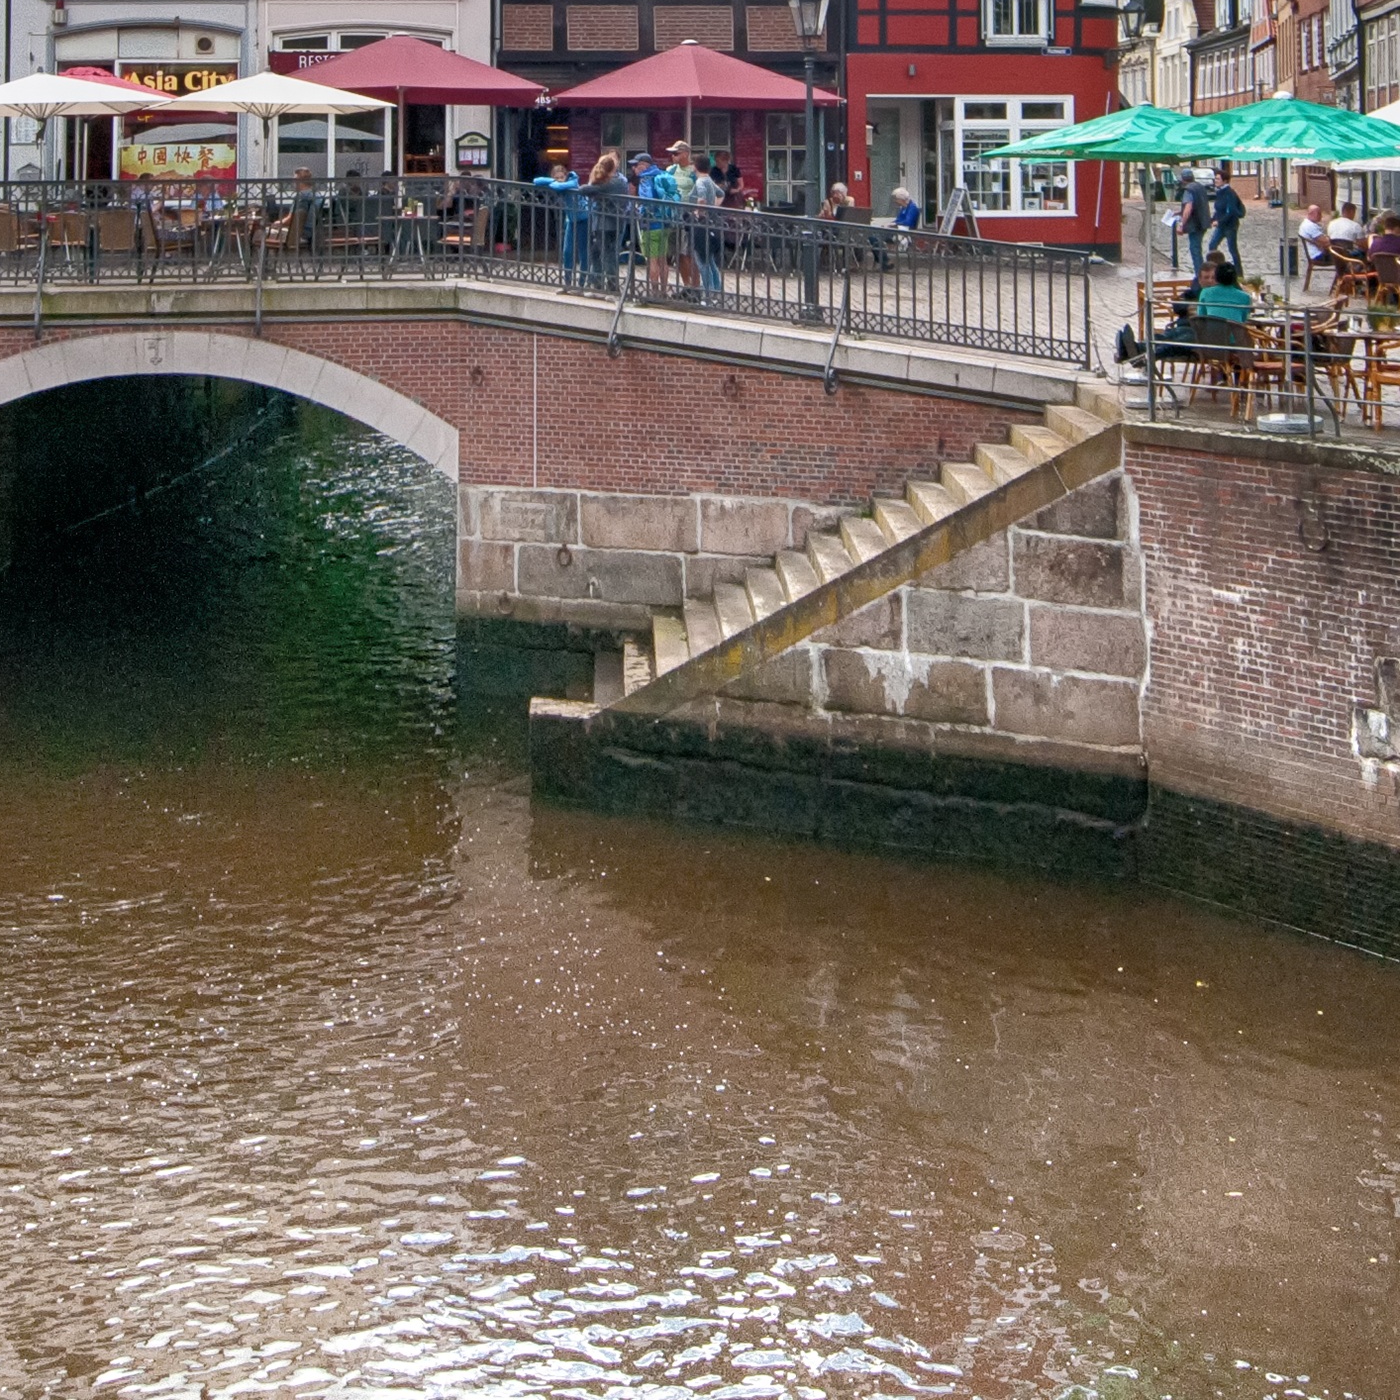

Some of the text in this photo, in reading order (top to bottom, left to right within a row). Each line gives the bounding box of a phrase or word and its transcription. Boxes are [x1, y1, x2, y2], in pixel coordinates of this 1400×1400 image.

[298, 54, 336, 69] REST
[126, 70, 232, 91] Asia City
[1245, 146, 1316, 155] Heineken
